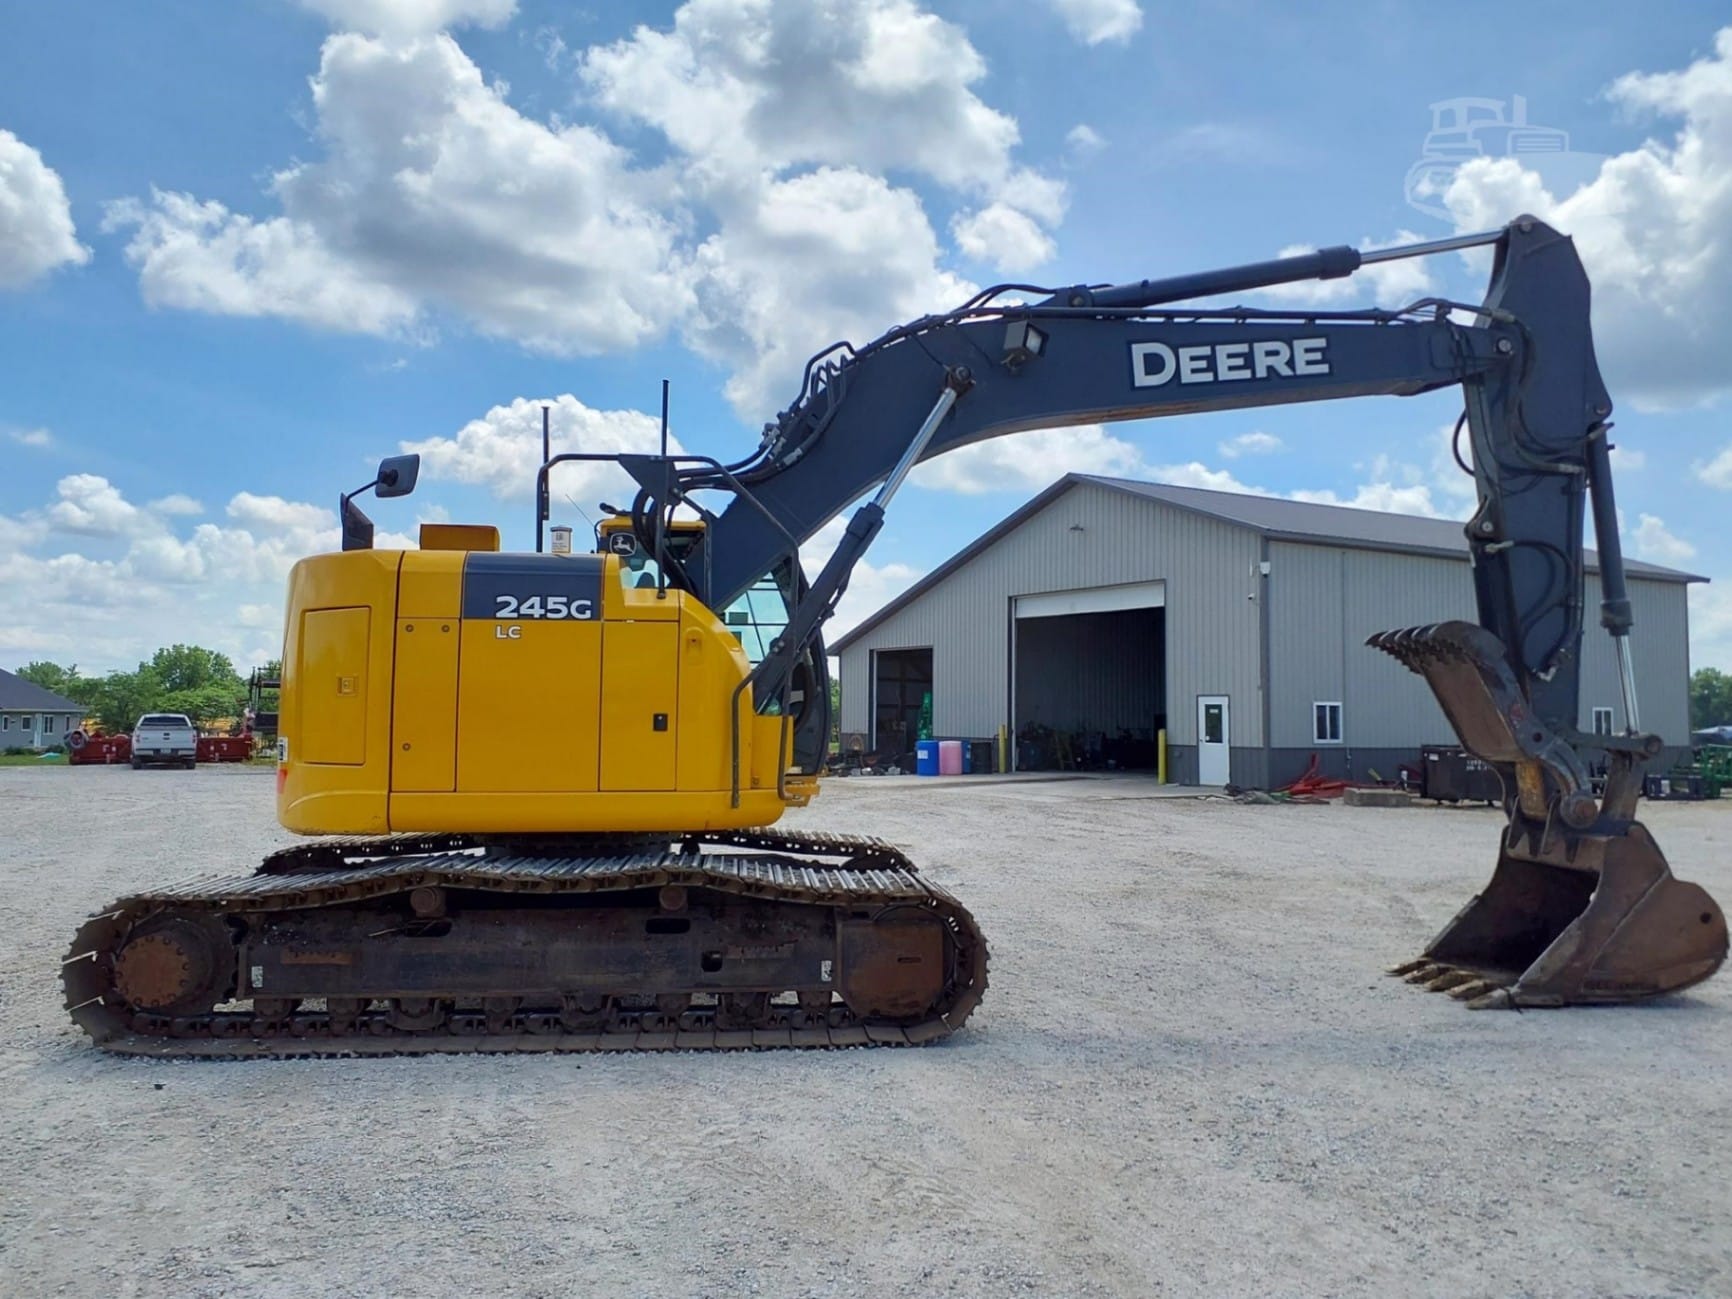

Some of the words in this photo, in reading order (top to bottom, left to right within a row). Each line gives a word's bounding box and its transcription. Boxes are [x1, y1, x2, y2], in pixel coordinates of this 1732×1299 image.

[1131, 337, 1330, 388] DEERE
[495, 595, 592, 619] 245G
[496, 625, 521, 639] LC
